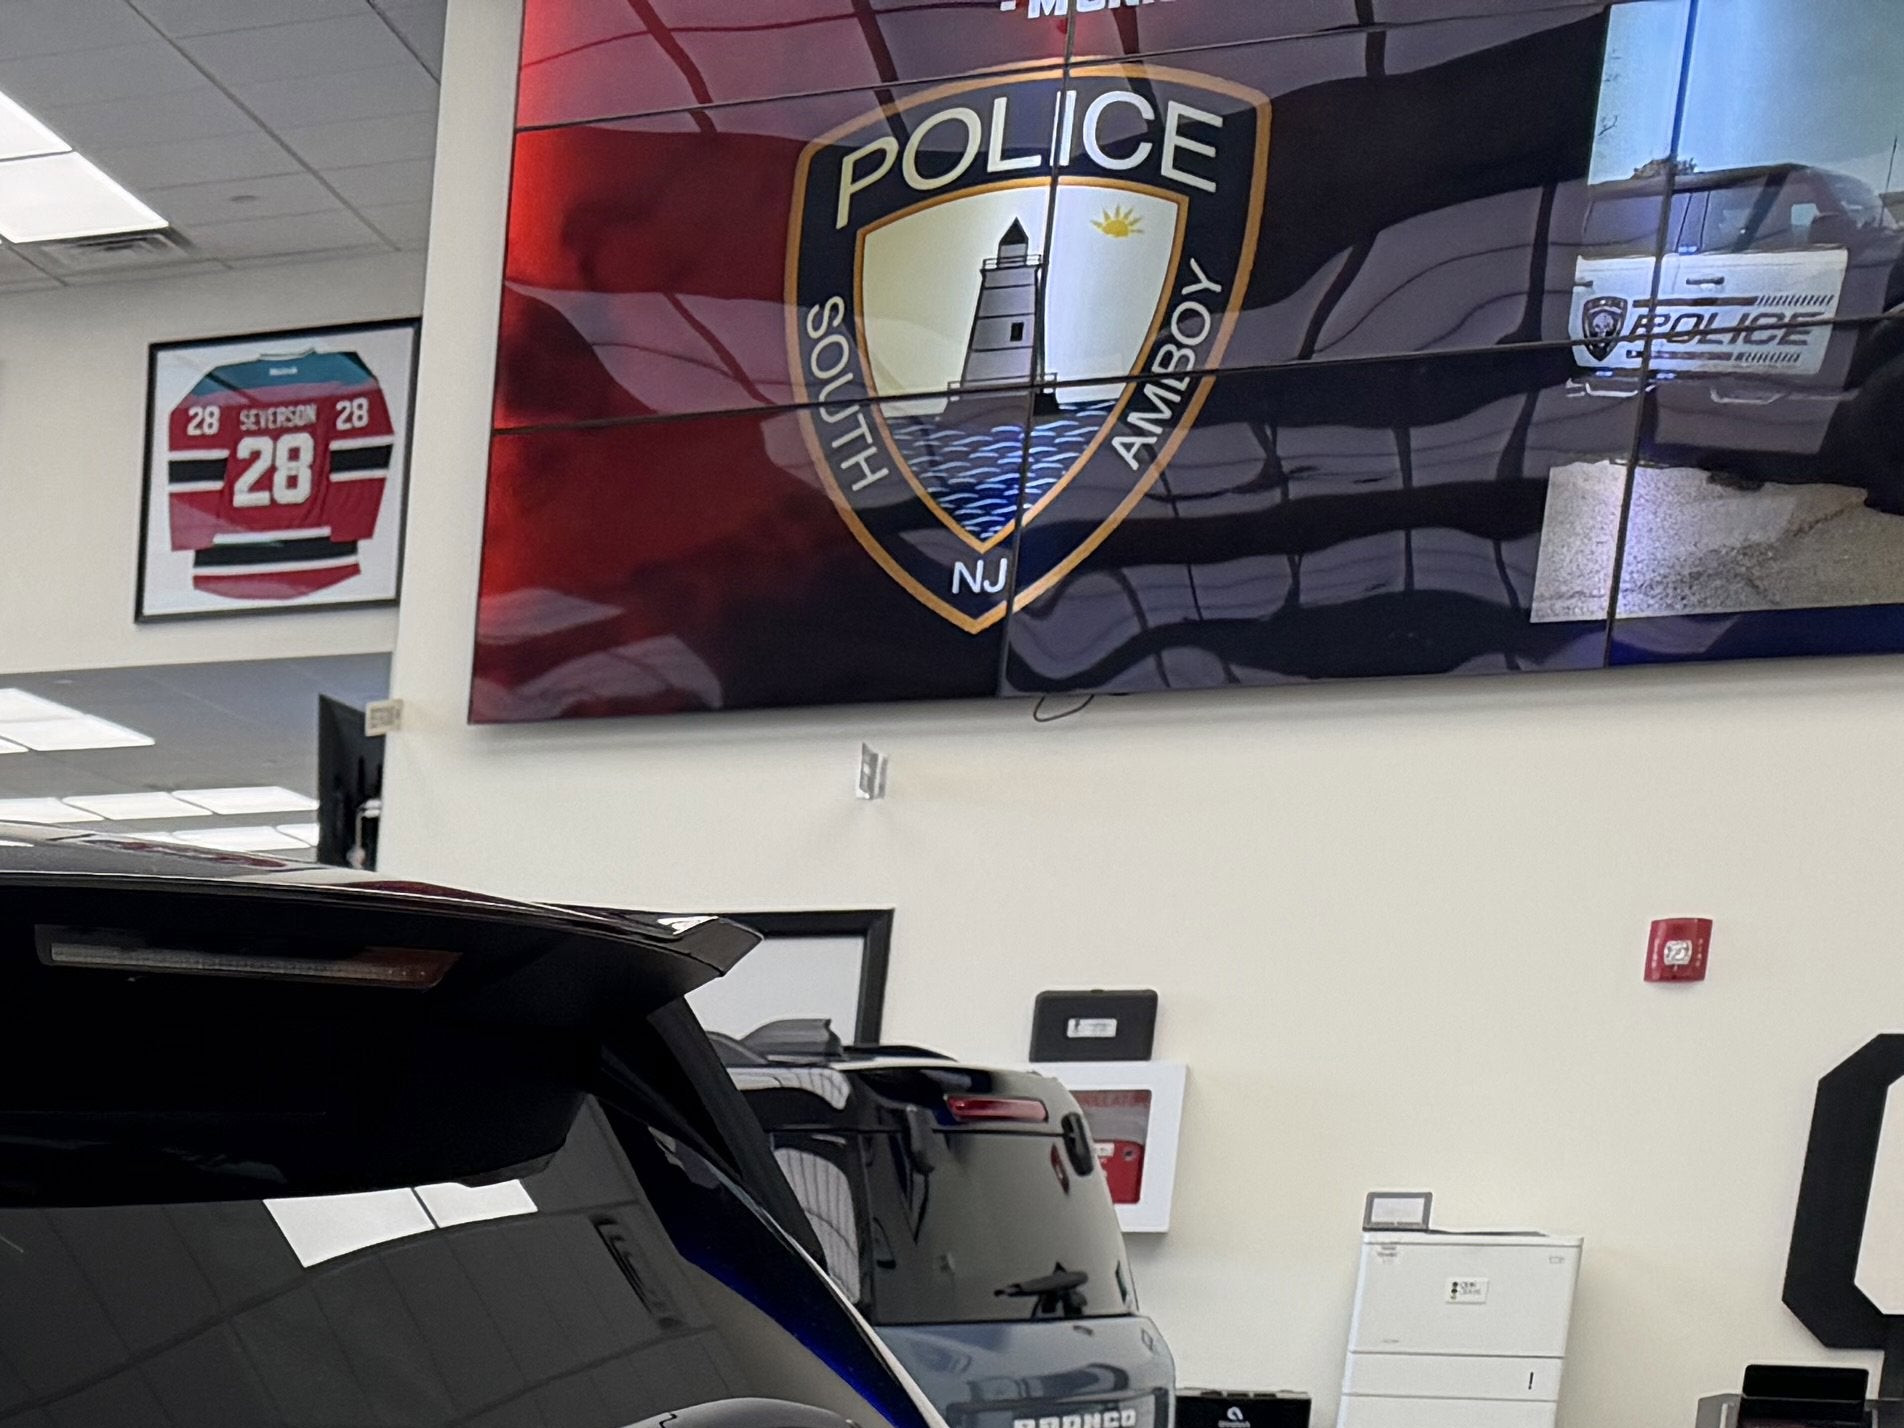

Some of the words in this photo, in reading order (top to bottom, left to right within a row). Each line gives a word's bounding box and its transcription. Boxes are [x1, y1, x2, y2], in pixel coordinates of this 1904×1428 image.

[835, 89, 1224, 231] POLICE
[1627, 311, 1826, 347] POLICE
[1111, 257, 1223, 471] AMBOY
[806, 295, 890, 492] SOUTH
[186, 405, 221, 436] 28
[239, 403, 318, 431] SEVERSON
[336, 397, 369, 430] 28
[232, 431, 315, 508] 28
[952, 558, 1008, 594] NJ
